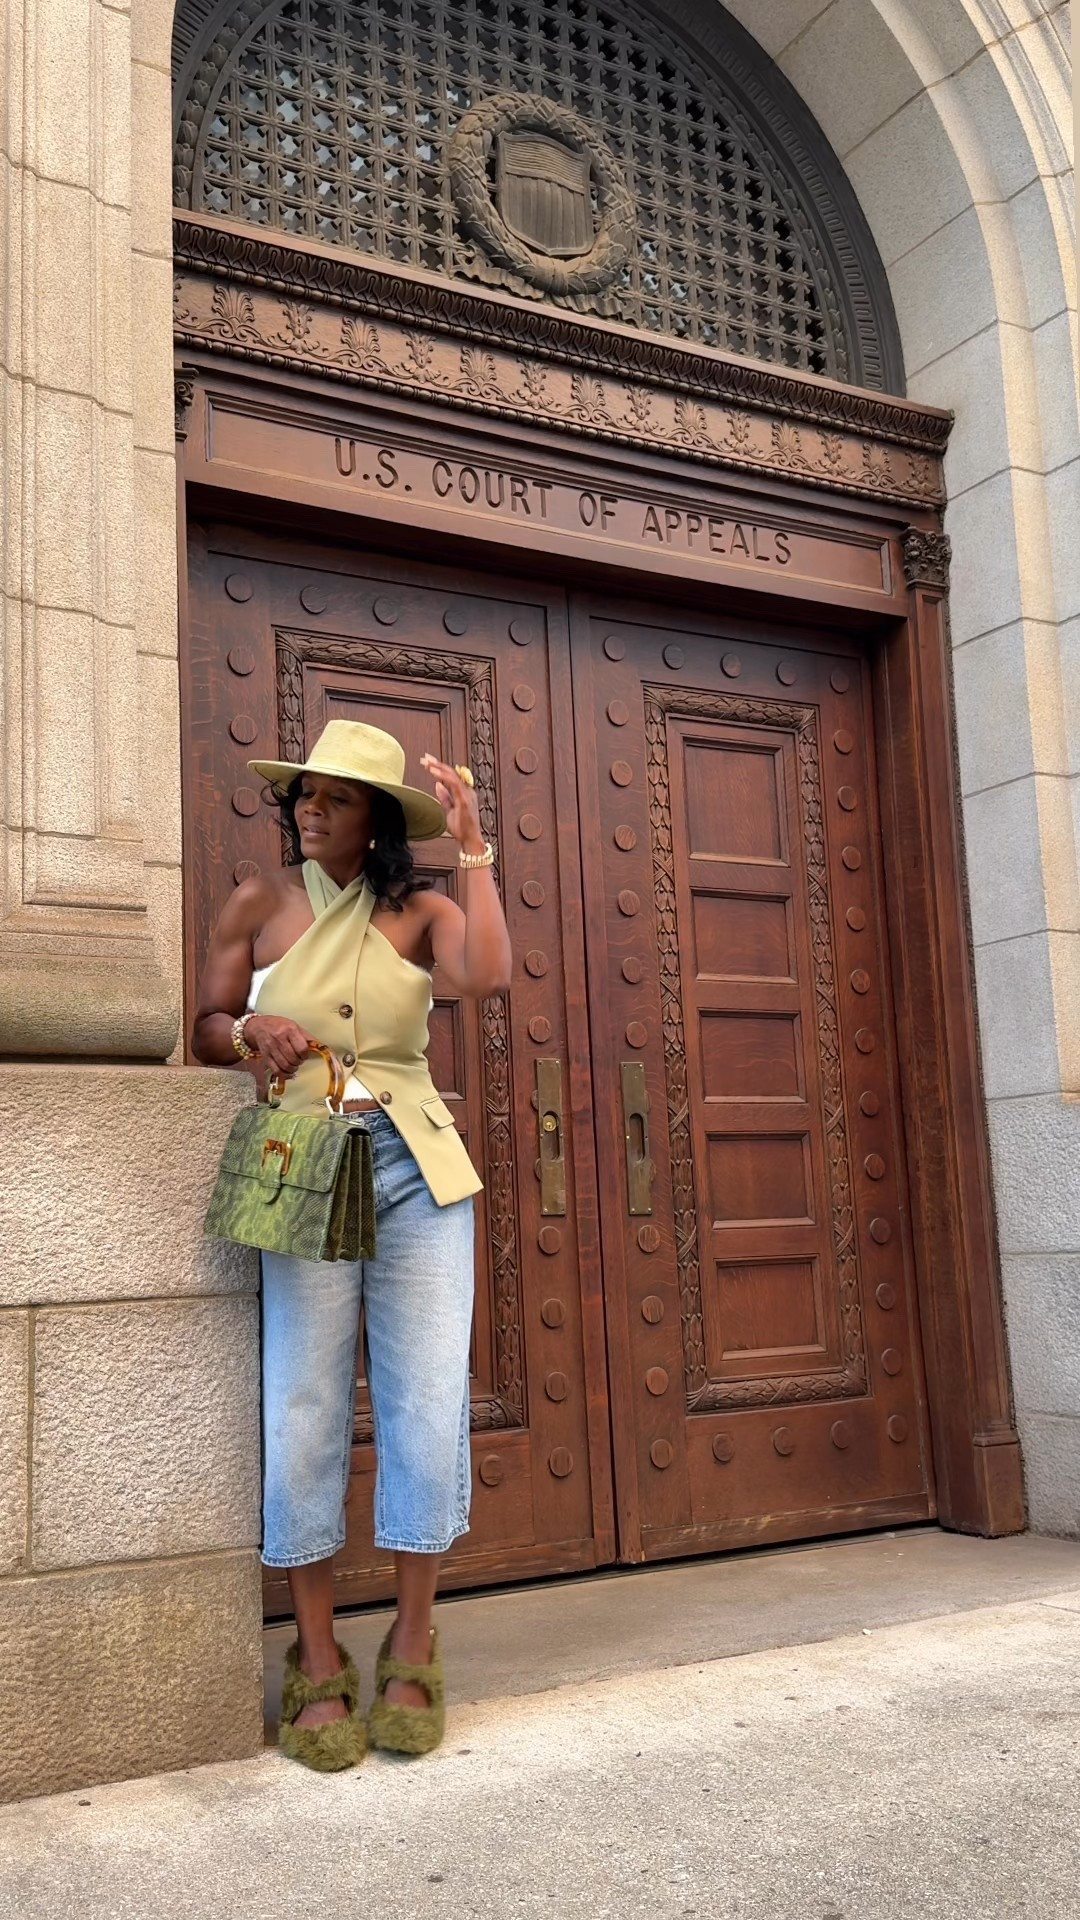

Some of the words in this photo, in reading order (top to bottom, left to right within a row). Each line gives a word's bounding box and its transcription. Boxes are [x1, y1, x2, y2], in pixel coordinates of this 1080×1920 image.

[334, 437, 413, 493] U.S.
[432, 460, 553, 519] COURT
[578, 492, 619, 531] OF
[641, 506, 792, 566] APPEALS
